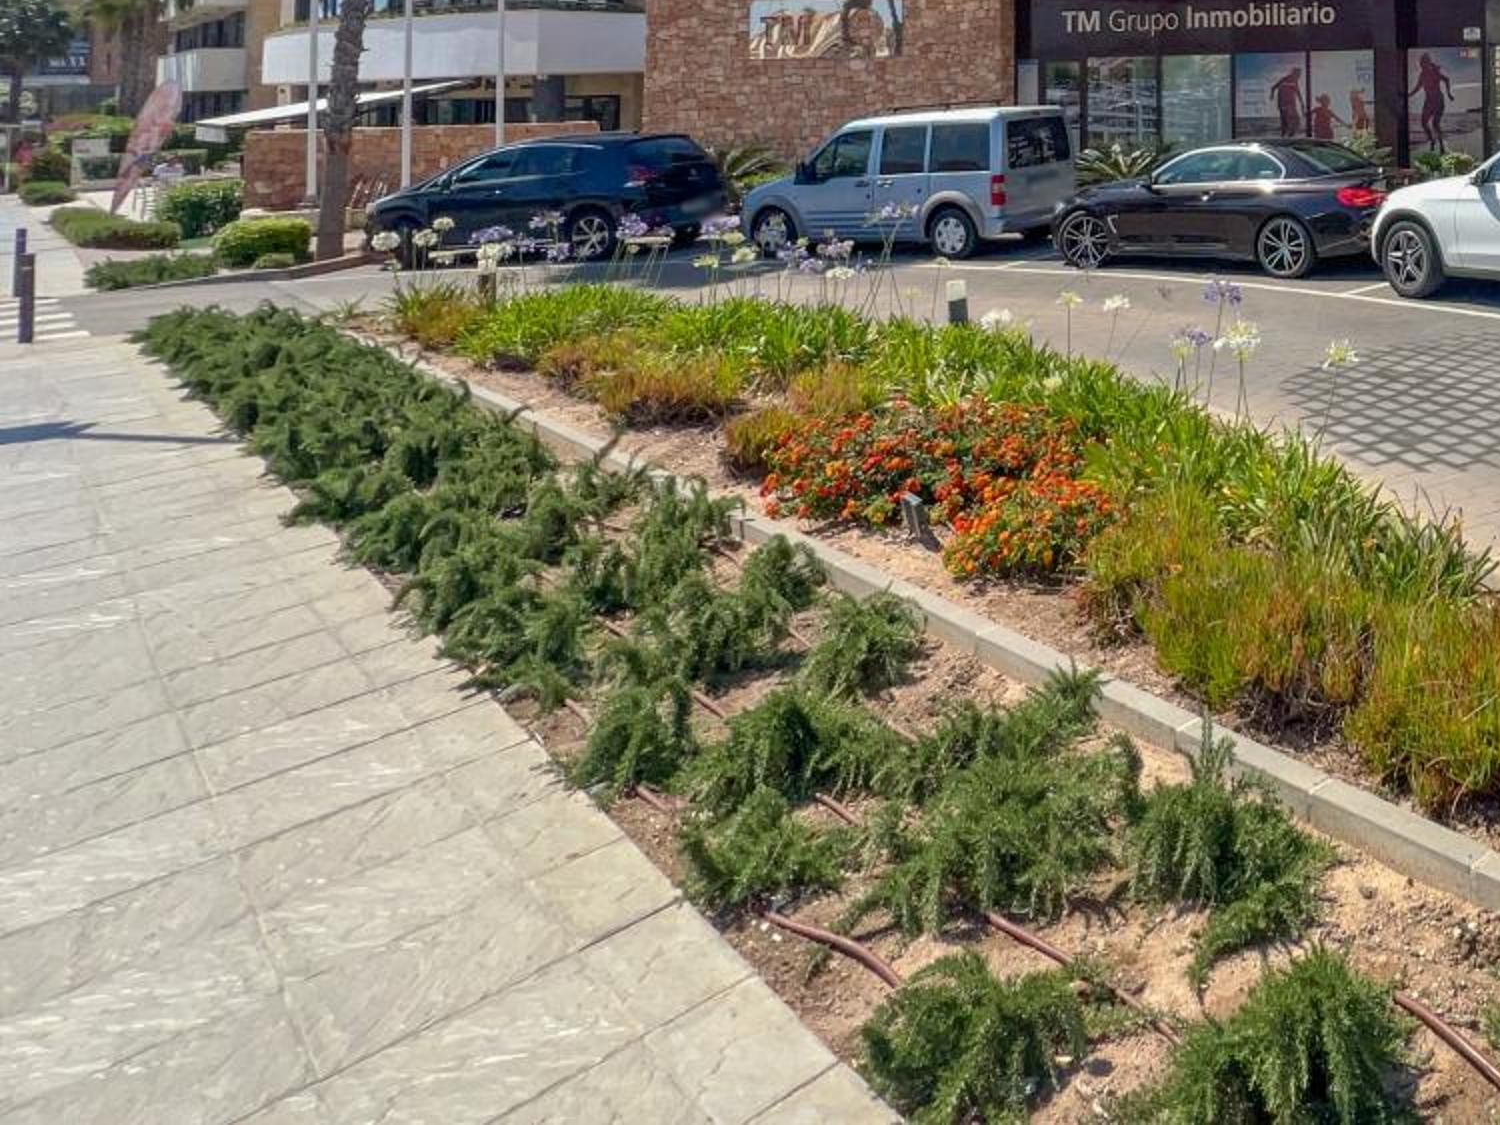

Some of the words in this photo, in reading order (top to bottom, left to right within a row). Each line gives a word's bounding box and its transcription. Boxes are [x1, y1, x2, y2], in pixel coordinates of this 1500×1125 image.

[1061, 9, 1101, 34] TM
[1108, 9, 1180, 37] Grupo
[1185, 1, 1337, 31] Inmobiliario
